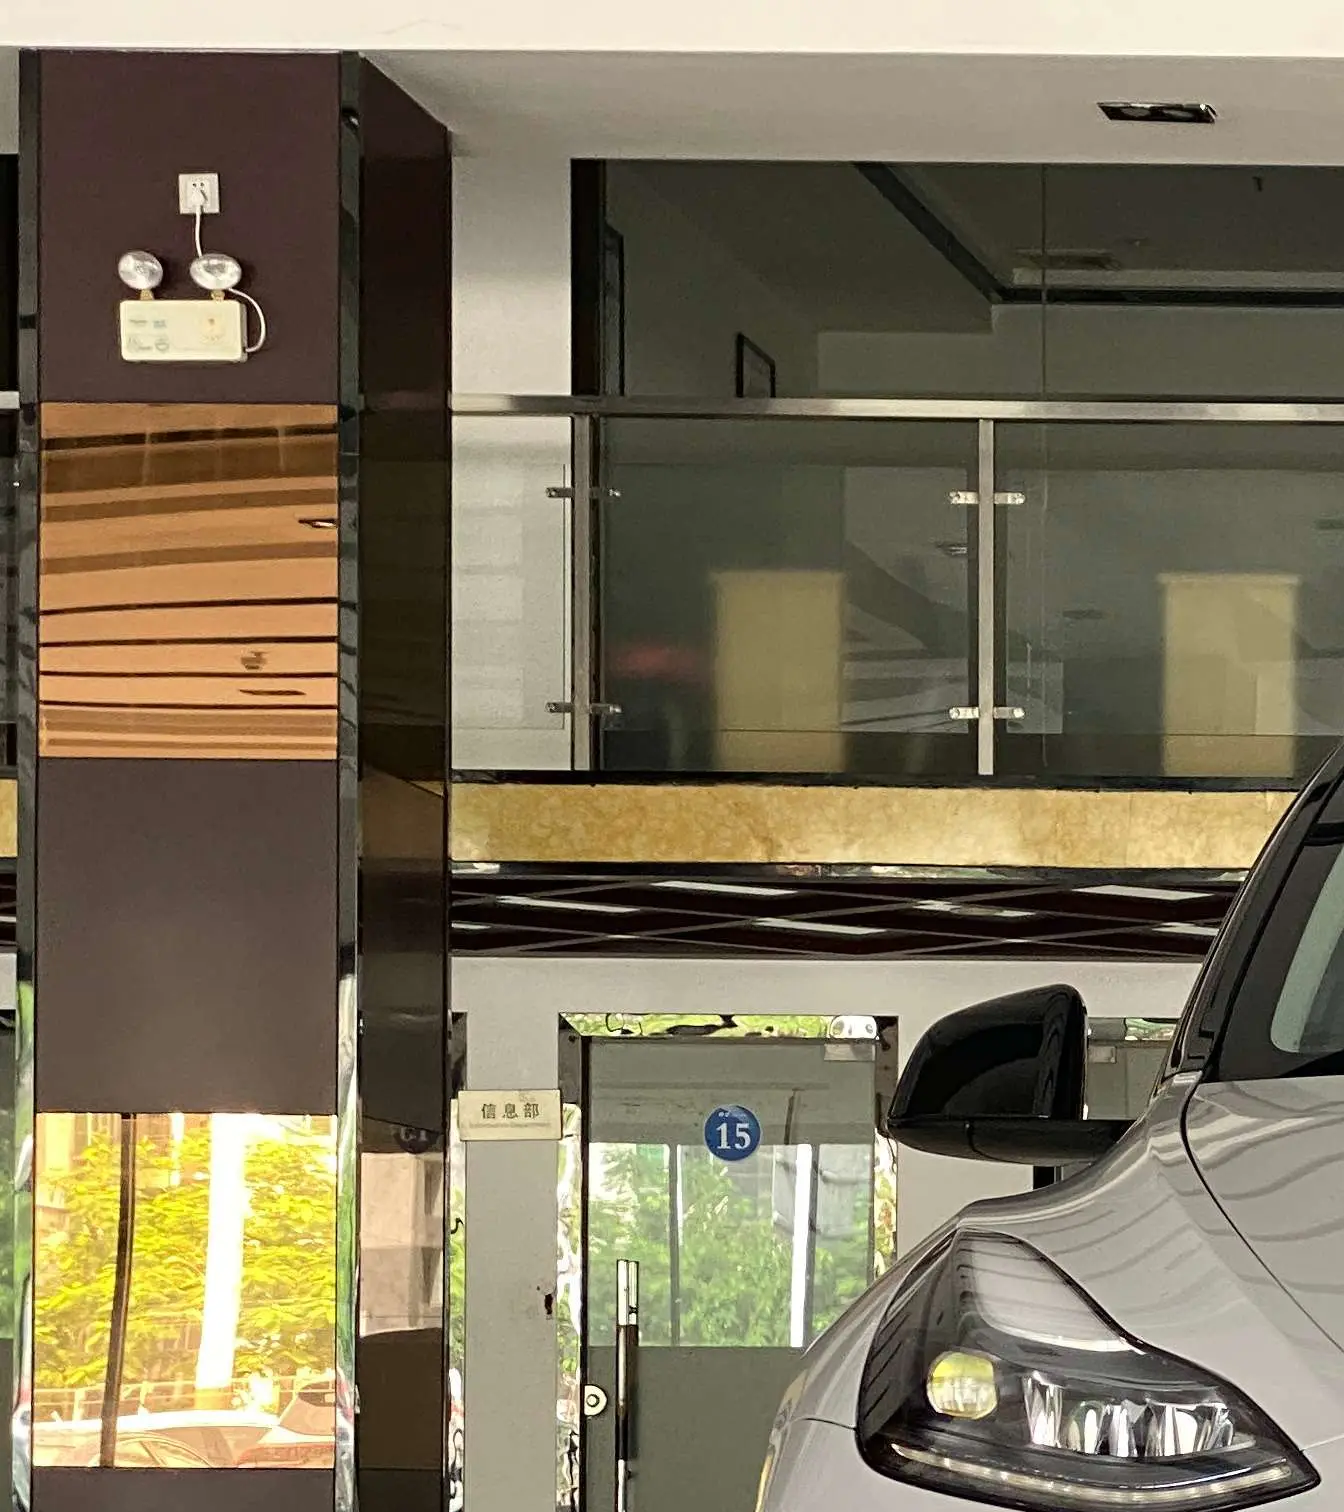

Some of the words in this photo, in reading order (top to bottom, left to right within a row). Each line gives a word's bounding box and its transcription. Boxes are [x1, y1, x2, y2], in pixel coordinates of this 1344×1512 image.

[481, 1102, 540, 1119] 信息部
[716, 1122, 751, 1149] 15
